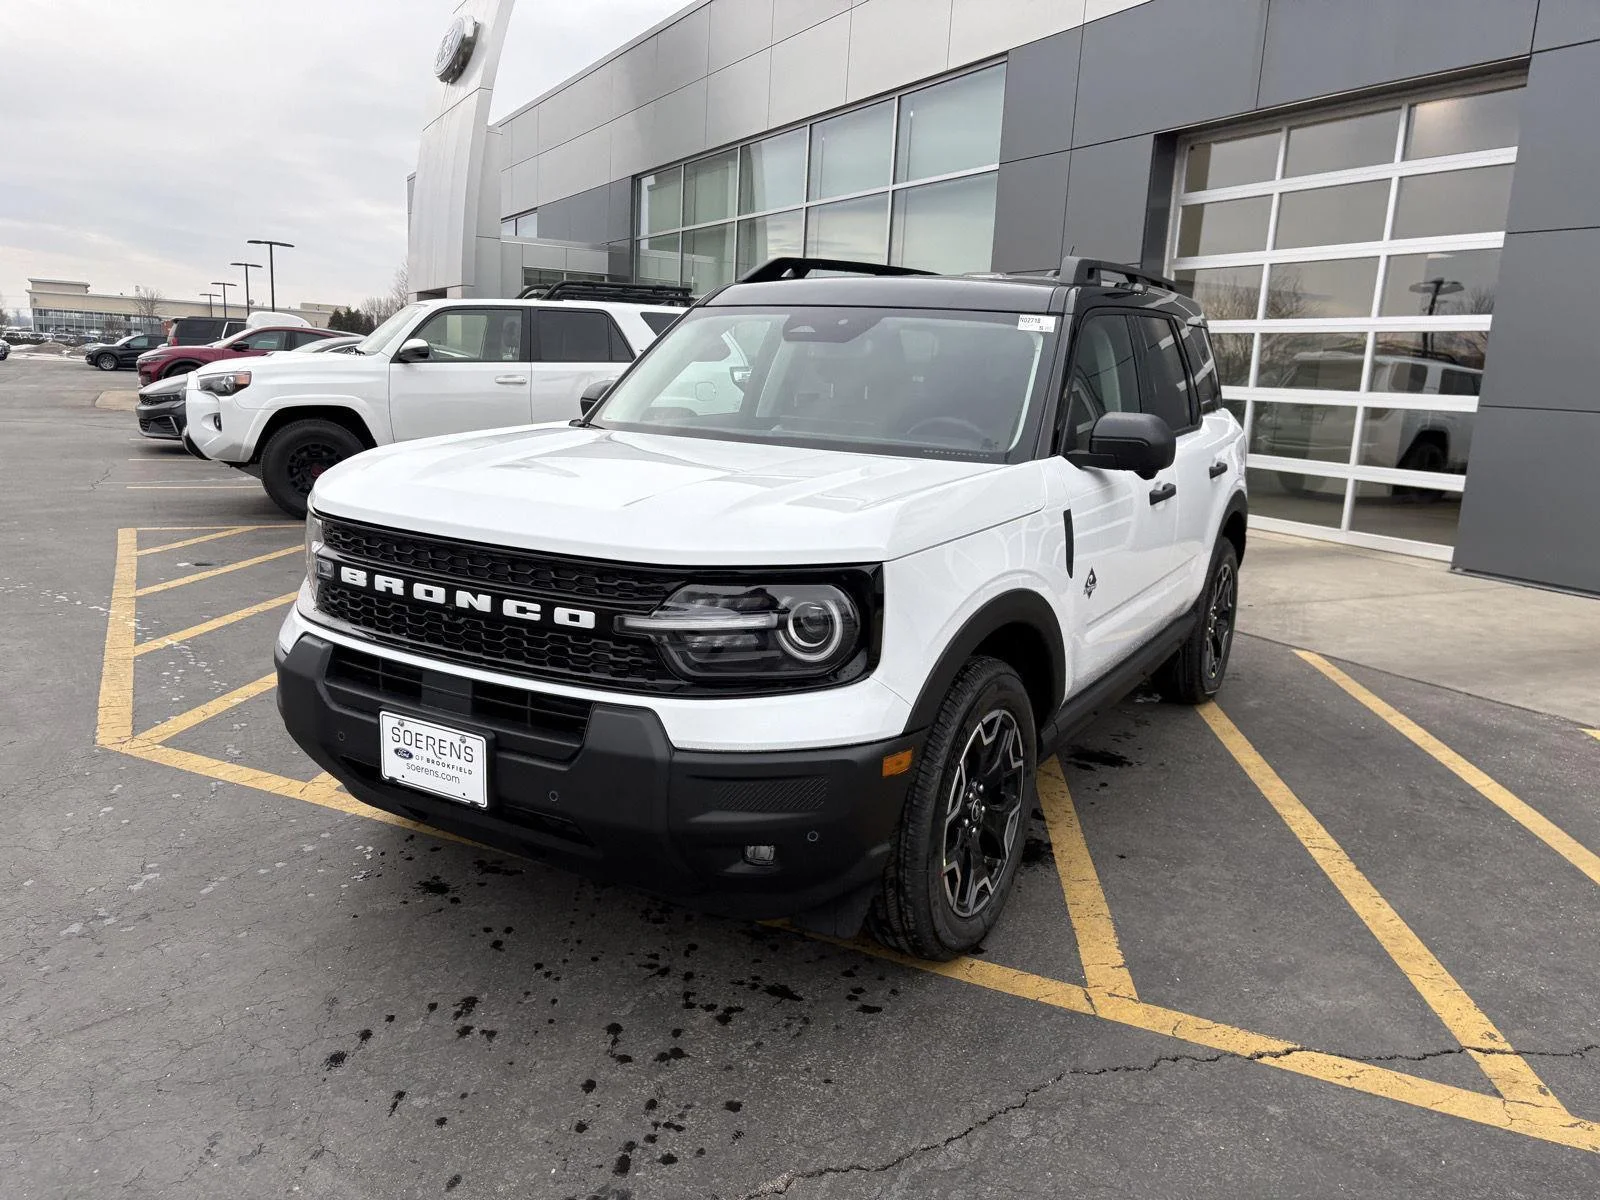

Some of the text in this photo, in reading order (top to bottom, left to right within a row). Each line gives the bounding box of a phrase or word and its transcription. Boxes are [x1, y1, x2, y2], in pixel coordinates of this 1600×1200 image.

[341, 566, 596, 629] BRONCO
[391, 726, 475, 764] SOERENS
[406, 762, 461, 784] soerens.com
[426, 757, 473, 776] BROOKFIELD
